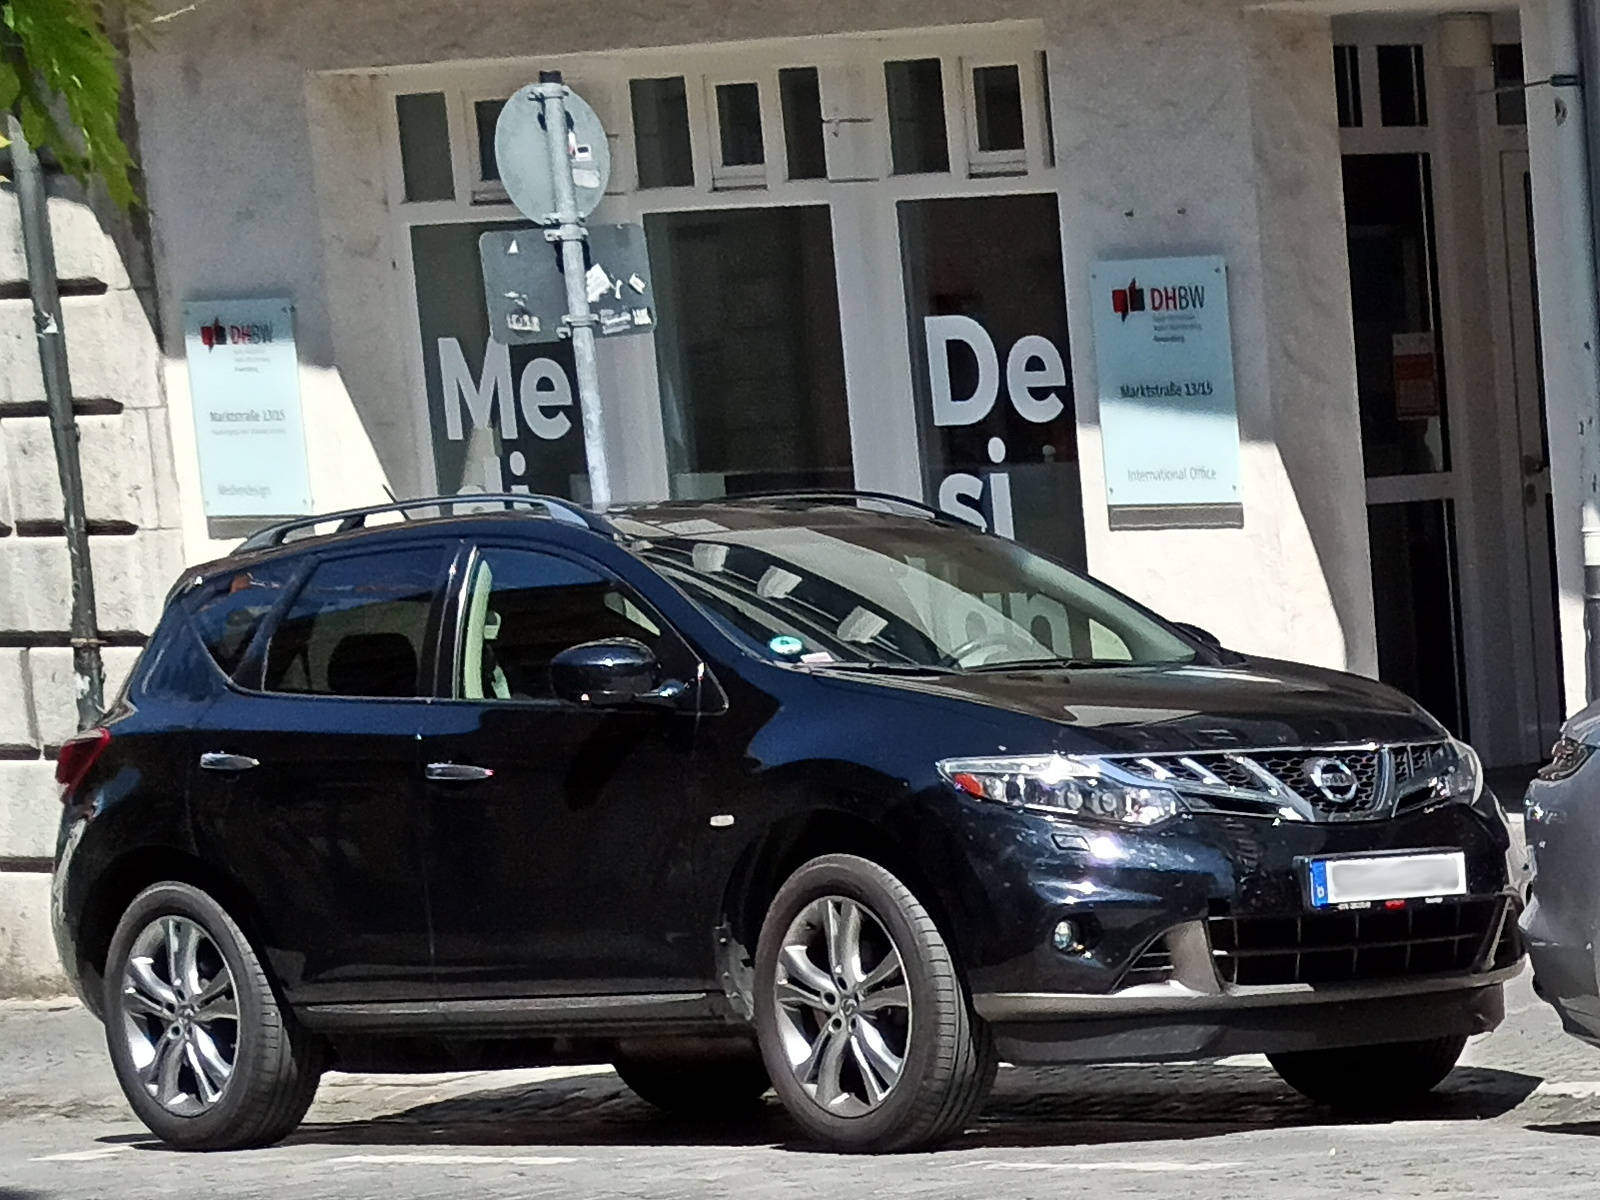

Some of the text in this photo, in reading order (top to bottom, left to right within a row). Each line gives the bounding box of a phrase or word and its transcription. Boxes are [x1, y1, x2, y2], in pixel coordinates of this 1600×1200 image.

[1150, 285, 1204, 311] DHBW
[230, 323, 273, 344] DHBW
[924, 315, 1066, 426] De
[438, 337, 573, 440] Me
[1127, 465, 1217, 482] International Office
